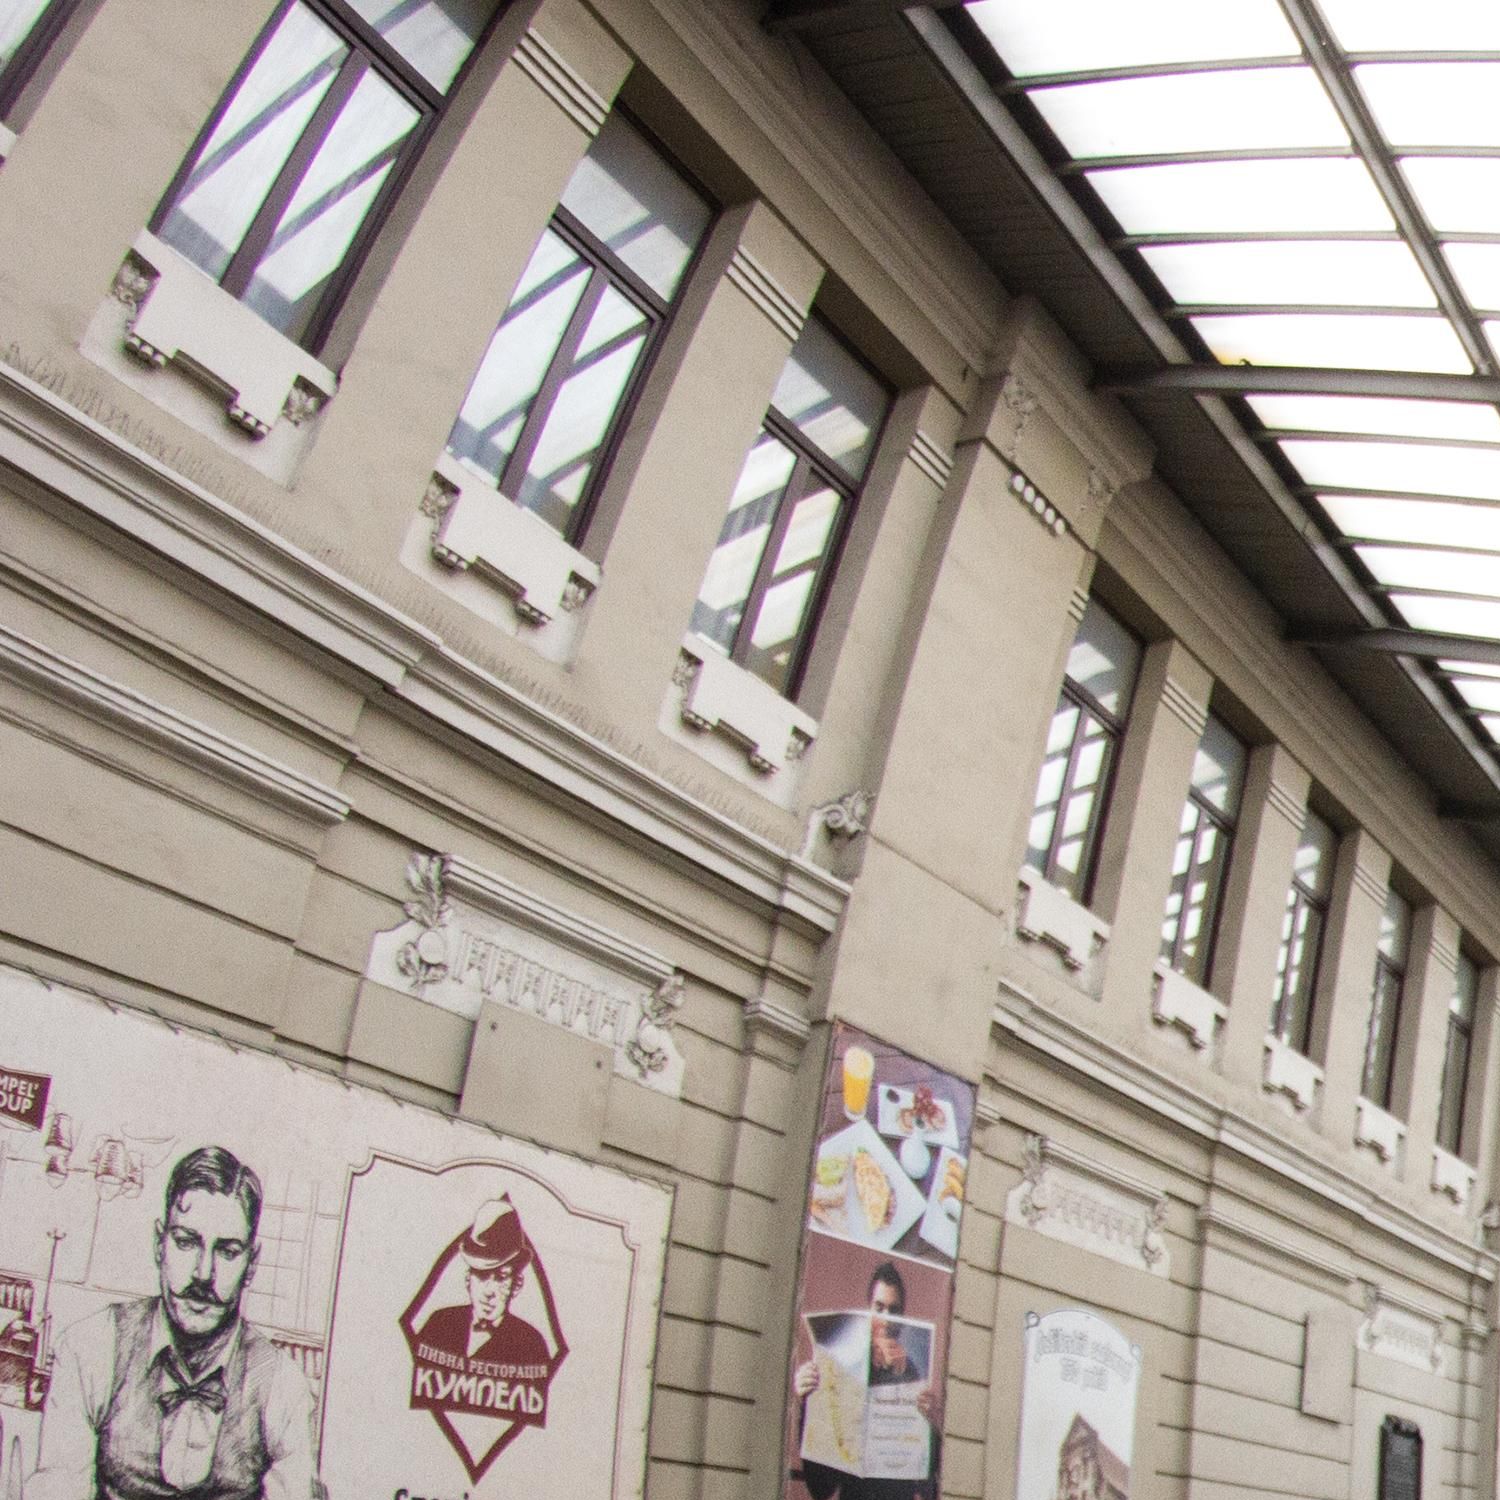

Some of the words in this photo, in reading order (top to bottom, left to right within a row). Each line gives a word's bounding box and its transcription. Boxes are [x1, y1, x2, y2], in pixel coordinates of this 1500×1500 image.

[417, 1343, 465, 1371] ПИВНА
[469, 1359, 548, 1379] РЕСТОРАЦІЯ
[415, 1367, 544, 1414] КУМПЕЛЬ
